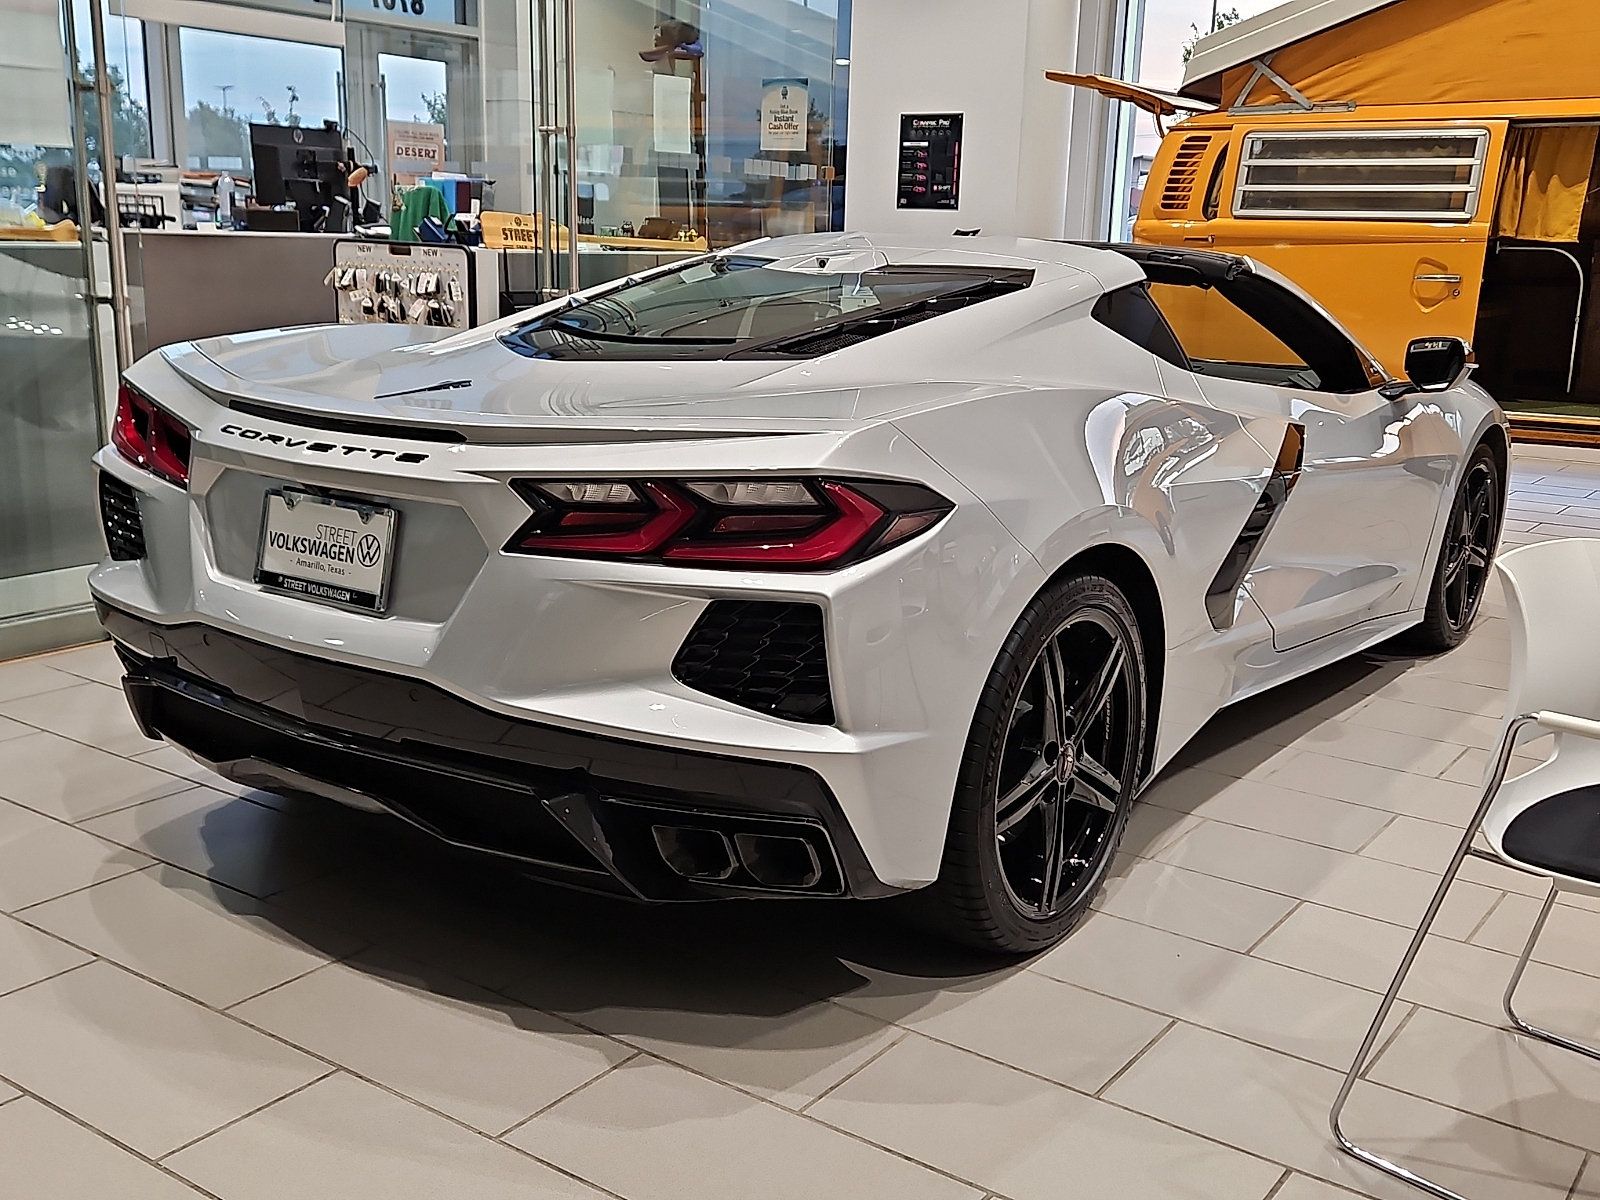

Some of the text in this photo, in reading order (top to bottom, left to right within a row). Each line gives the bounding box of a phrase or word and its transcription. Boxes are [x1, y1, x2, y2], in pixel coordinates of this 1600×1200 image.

[768, 122, 799, 130] Cash Offer
[773, 114, 795, 122] Instant
[396, 146, 437, 159] DESERT
[357, 245, 372, 253] NEW
[422, 249, 439, 257] NEW
[220, 424, 430, 464] CORVETTE
[316, 523, 358, 546] STREET
[269, 530, 356, 564] VOLKSWAGEN
[295, 557, 345, 576] Amarillo, Texas
[283, 578, 351, 602] STREET VOLKSWAGEN
